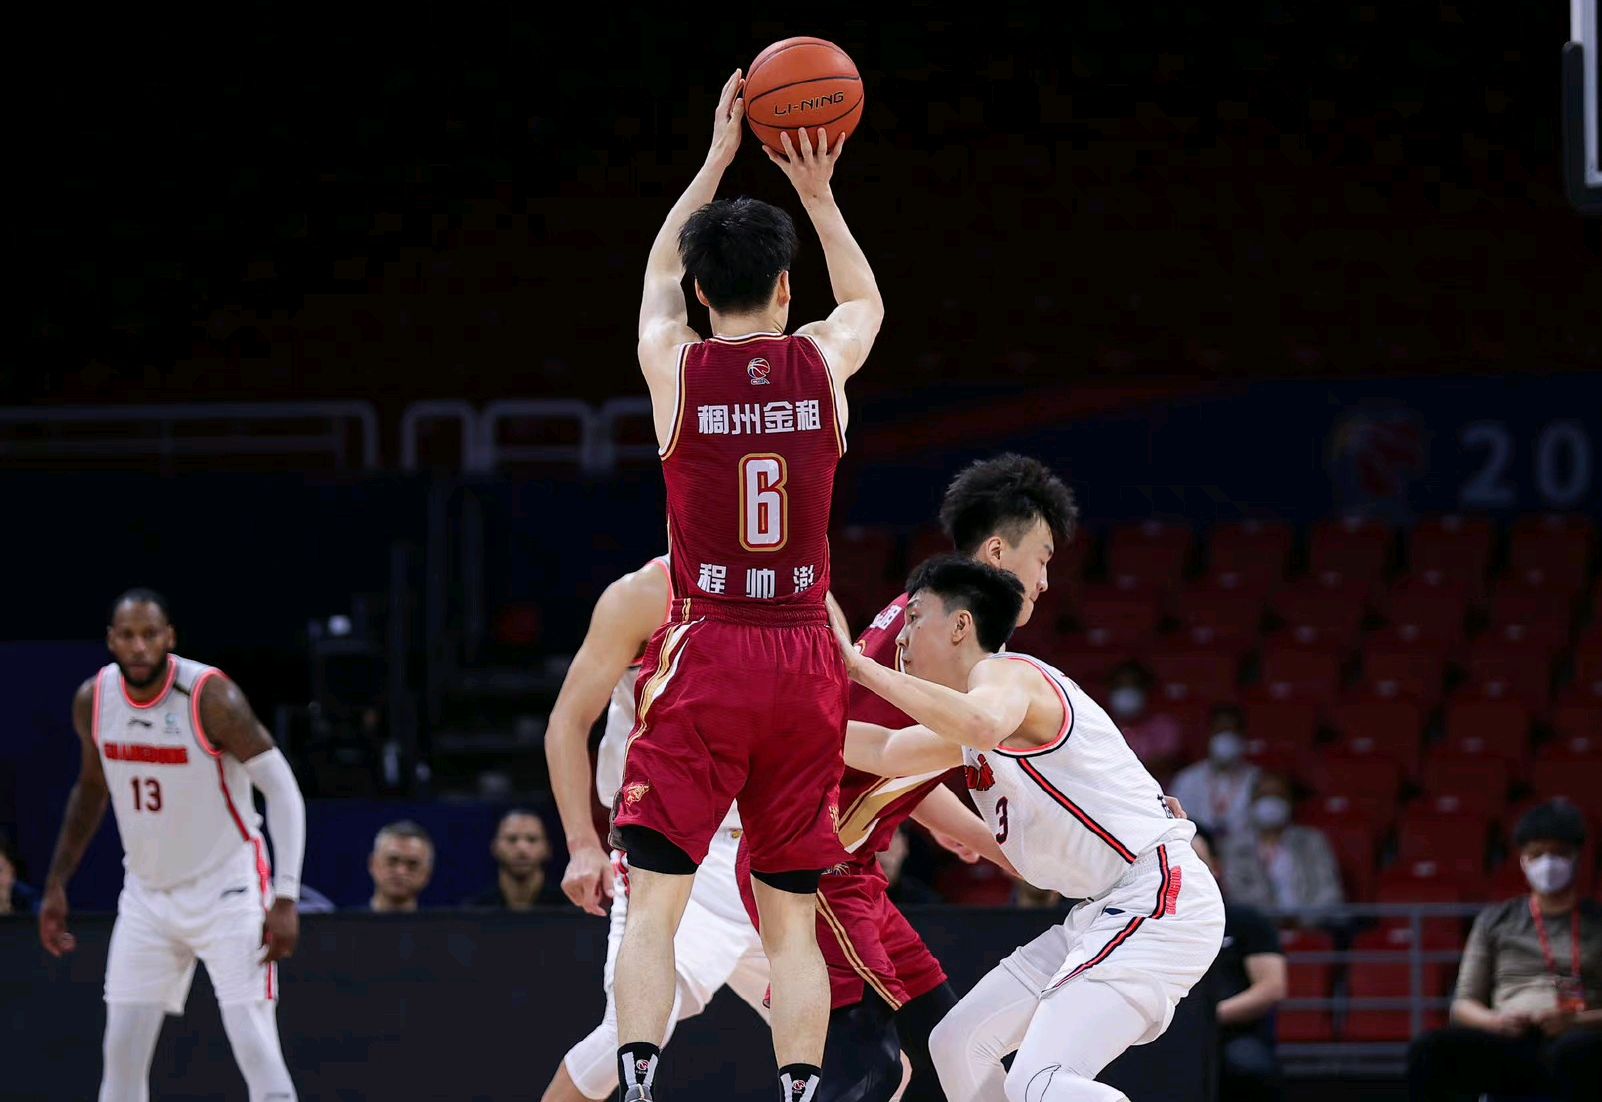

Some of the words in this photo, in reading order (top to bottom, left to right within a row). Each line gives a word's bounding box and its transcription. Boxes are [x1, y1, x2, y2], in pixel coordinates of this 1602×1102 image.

[774, 91, 844, 115] LI-NING
[697, 399, 821, 435] 稠州金租
[738, 453, 788, 552] 6
[131, 776, 163, 812] 13
[995, 796, 1009, 845] 3
